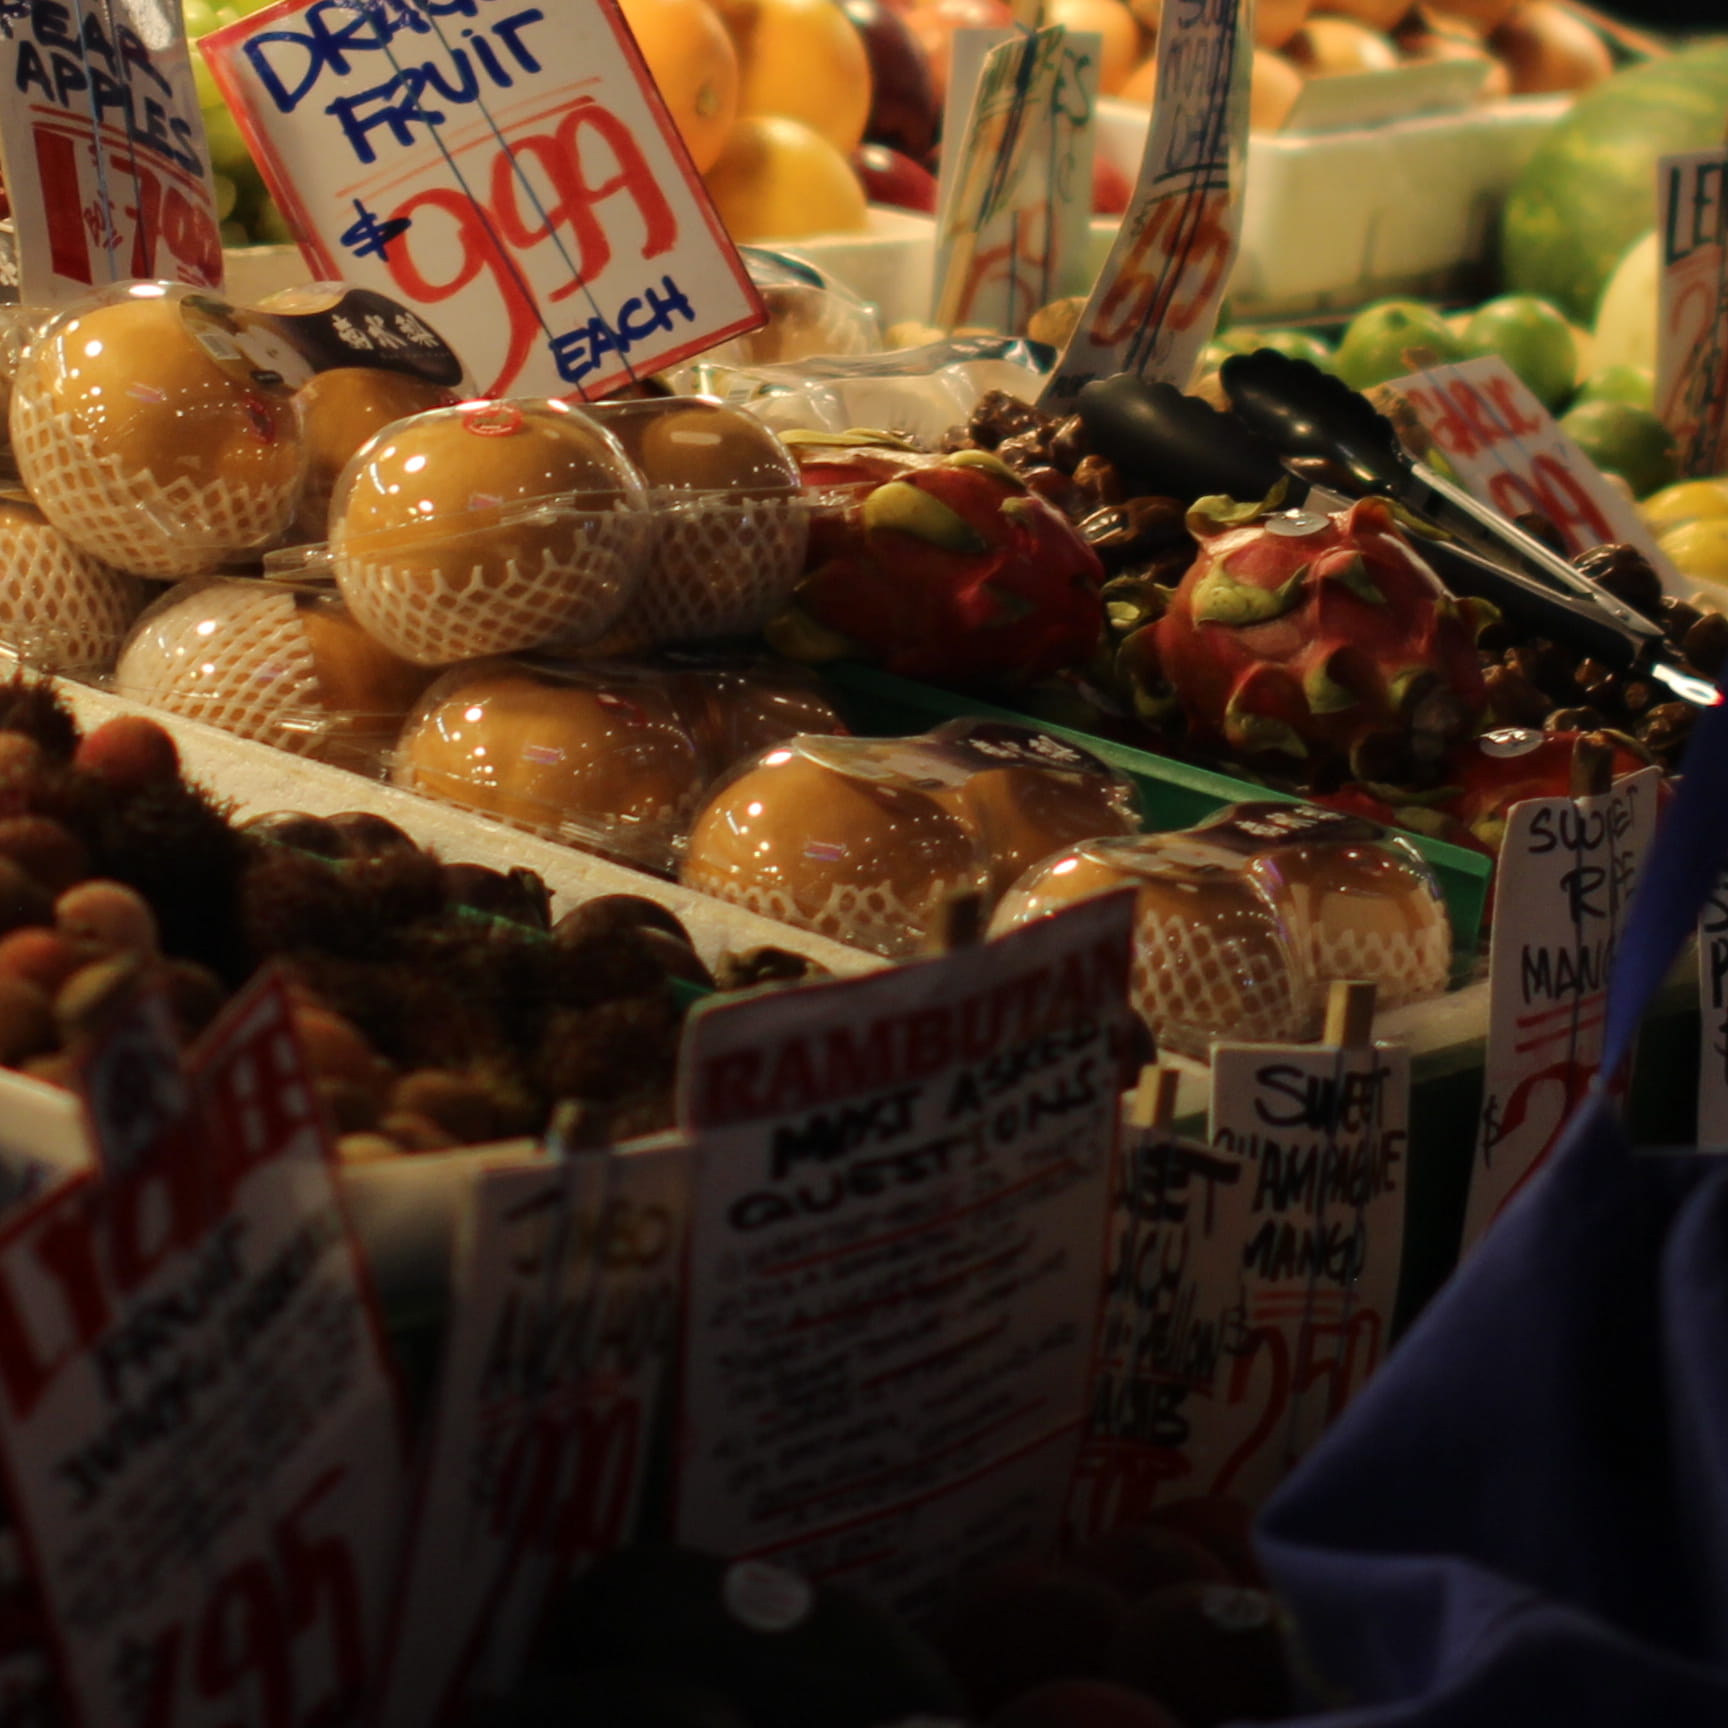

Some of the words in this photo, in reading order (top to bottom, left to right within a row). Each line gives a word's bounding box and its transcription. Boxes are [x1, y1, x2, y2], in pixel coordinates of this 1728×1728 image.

[16, 40, 205, 179] APPLES
[324, 7, 545, 165] FRUIT
[548, 274, 697, 384] EACH
[701, 938, 1130, 1120] RAMBUTAN
[729, 1059, 1098, 1230] QUESTIONS
